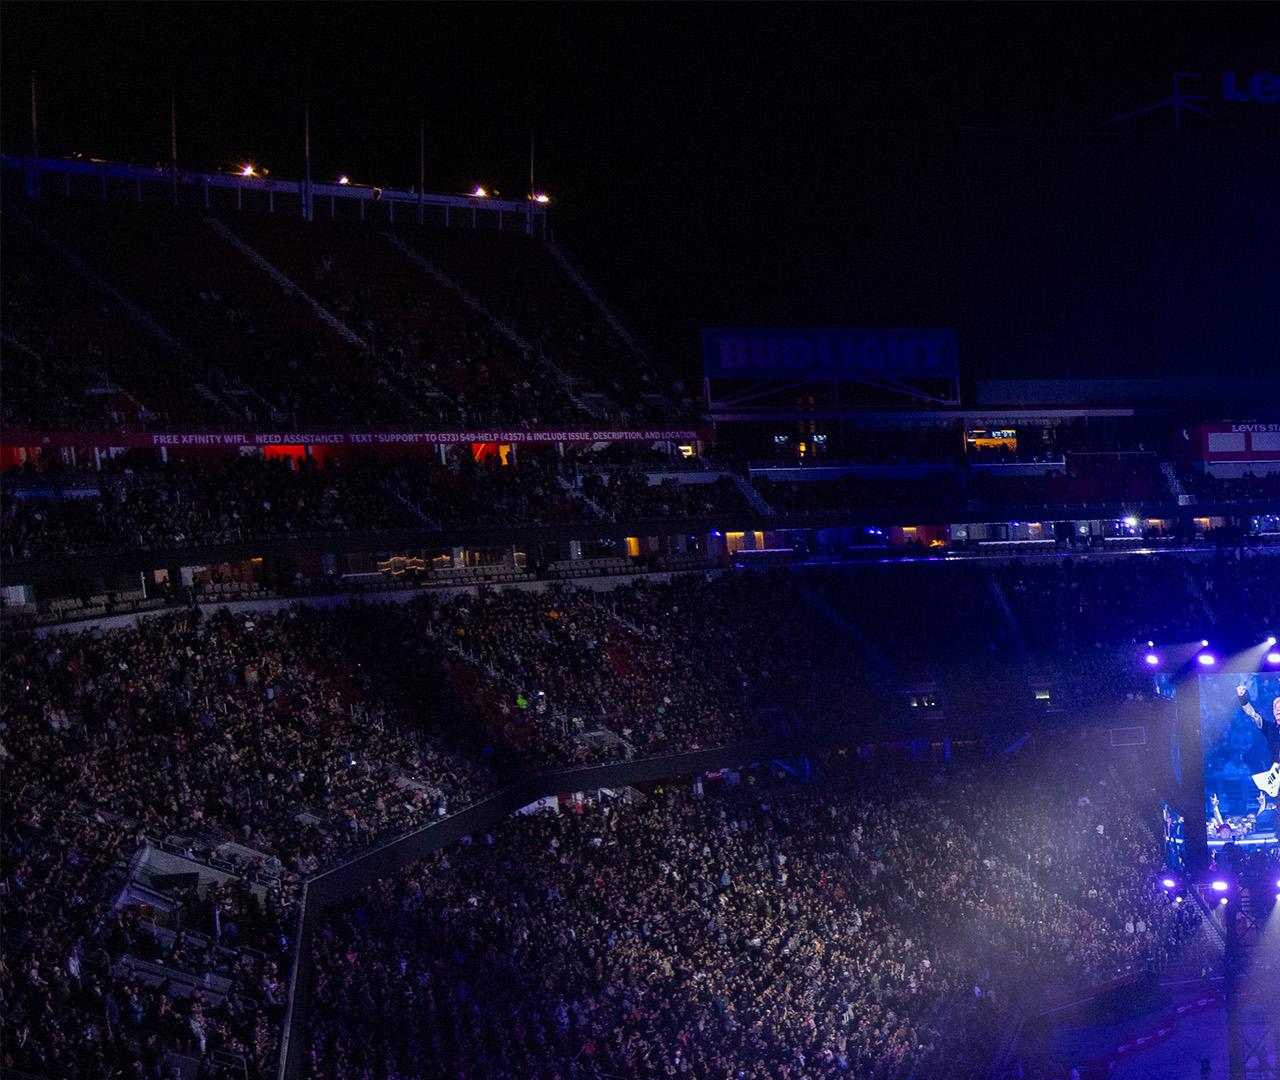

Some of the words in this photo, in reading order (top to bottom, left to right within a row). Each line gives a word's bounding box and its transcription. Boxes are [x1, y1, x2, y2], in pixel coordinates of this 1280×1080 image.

[153, 434, 180, 445] FREE
[181, 434, 222, 444] XFINITY
[255, 434, 281, 443] NEED
[283, 433, 344, 443] ASSISTANCE?
[350, 433, 373, 443] TEXT
[425, 433, 437, 443] TO
[534, 432, 567, 441] INCLUDE
[644, 431, 660, 440] AND
